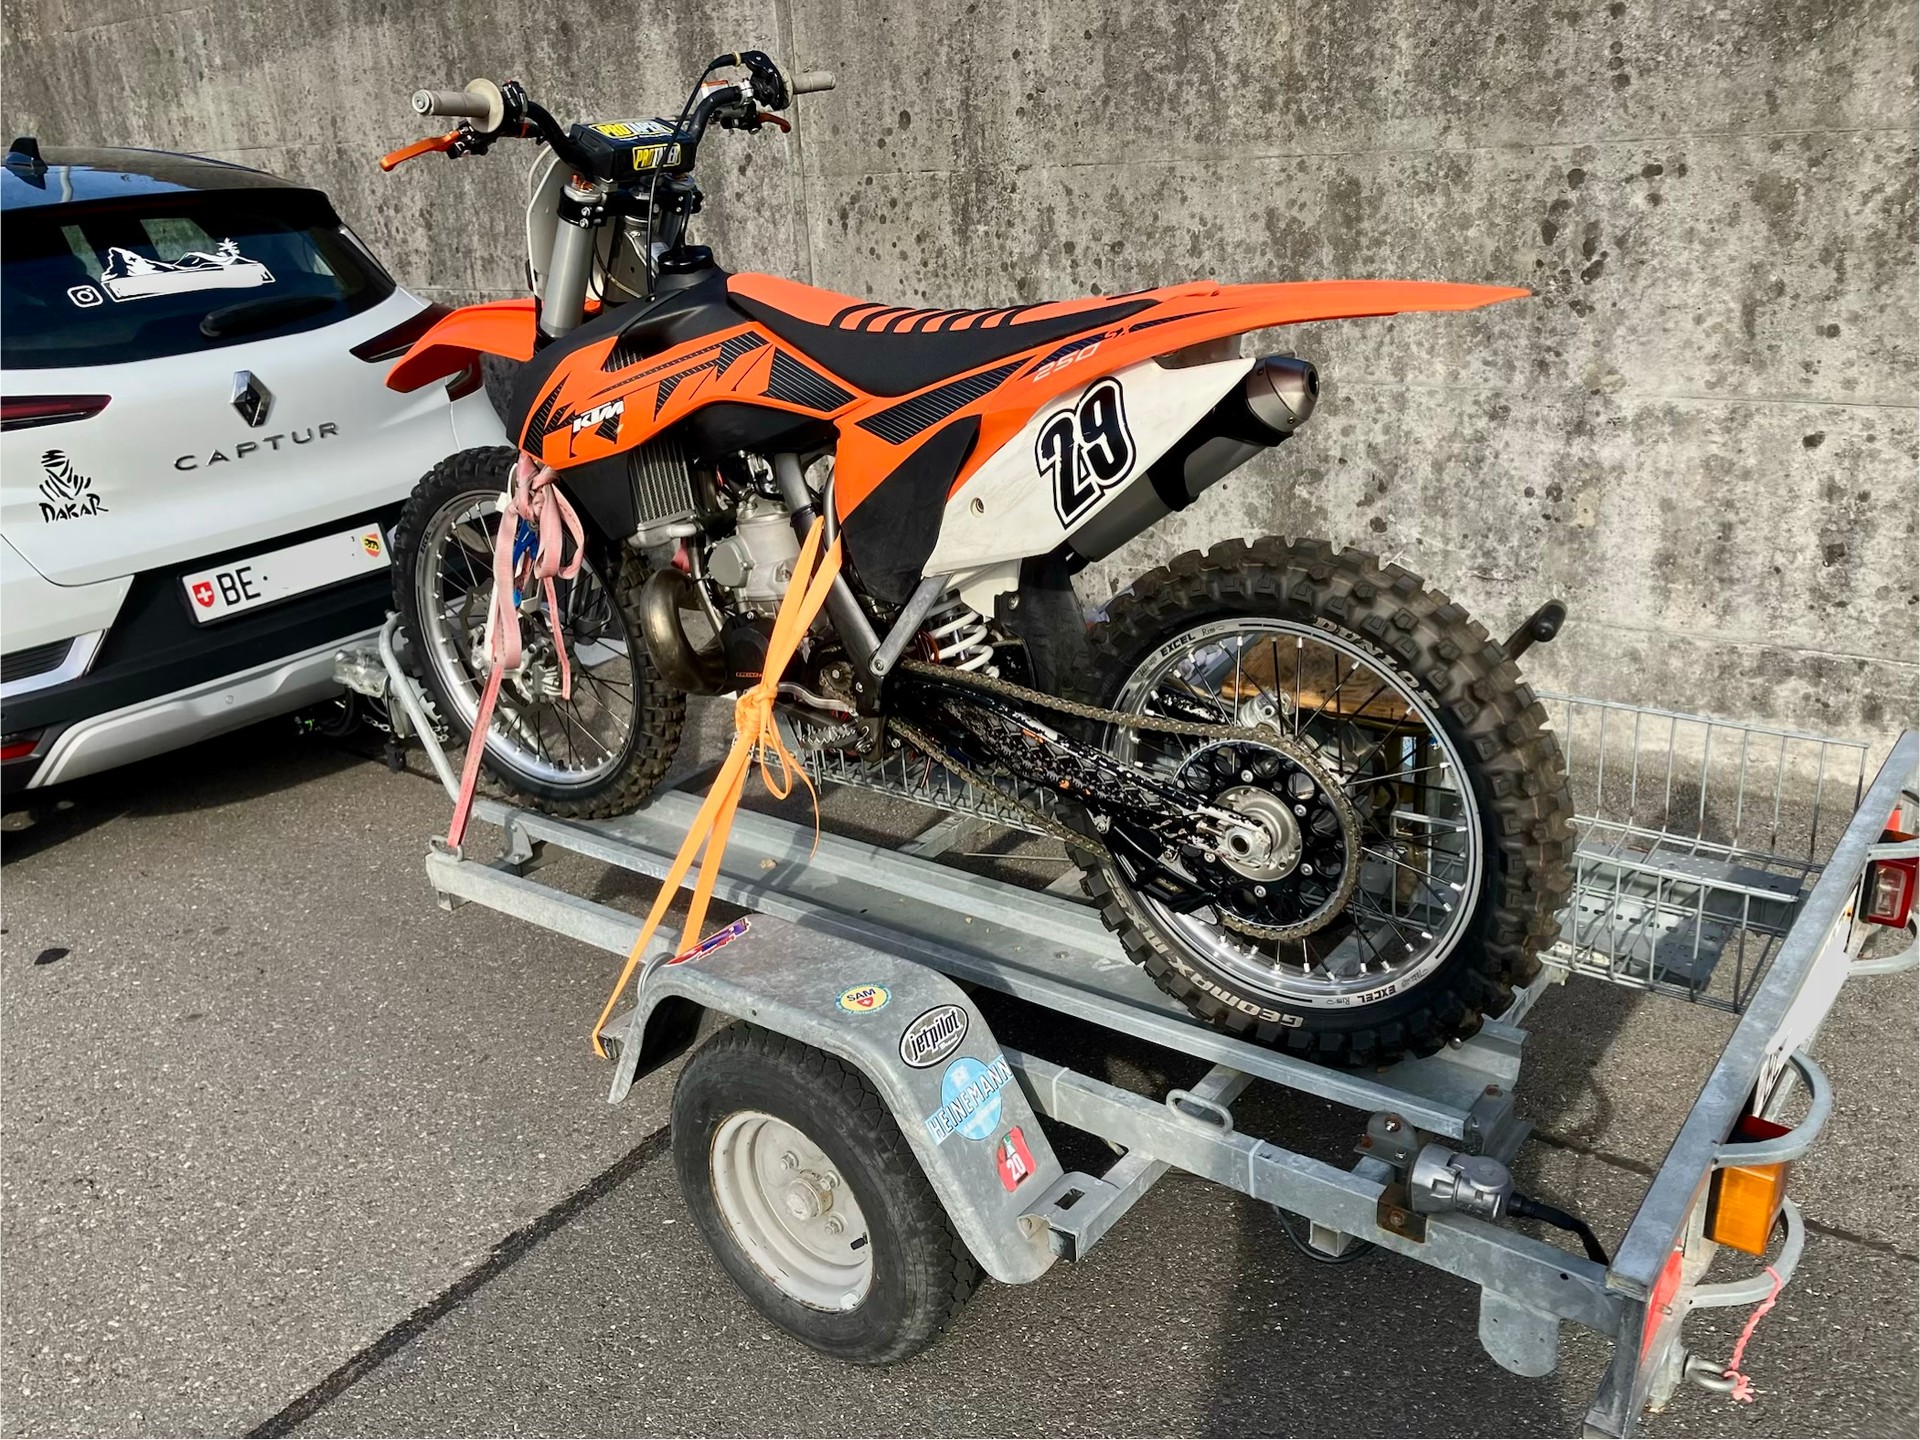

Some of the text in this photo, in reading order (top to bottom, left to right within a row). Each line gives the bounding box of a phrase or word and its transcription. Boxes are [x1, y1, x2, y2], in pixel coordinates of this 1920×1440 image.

[1033, 342, 1101, 382] 250
[573, 400, 625, 433] KTM
[173, 422, 339, 471] CAPTUR
[1035, 376, 1136, 530] 29
[39, 493, 109, 523] DAKAR
[216, 566, 261, 606] BE
[1160, 633, 1195, 657] EXCEL
[1313, 616, 1439, 709] DUNLOP
[847, 988, 876, 1002] SAM
[1168, 955, 1304, 1027] GEOMAX
[1357, 984, 1397, 1003] EXCEL
[910, 1010, 960, 1061] jetpilot
[928, 1057, 1013, 1138] HEINEMANN
[1006, 1152, 1026, 1182] 20
